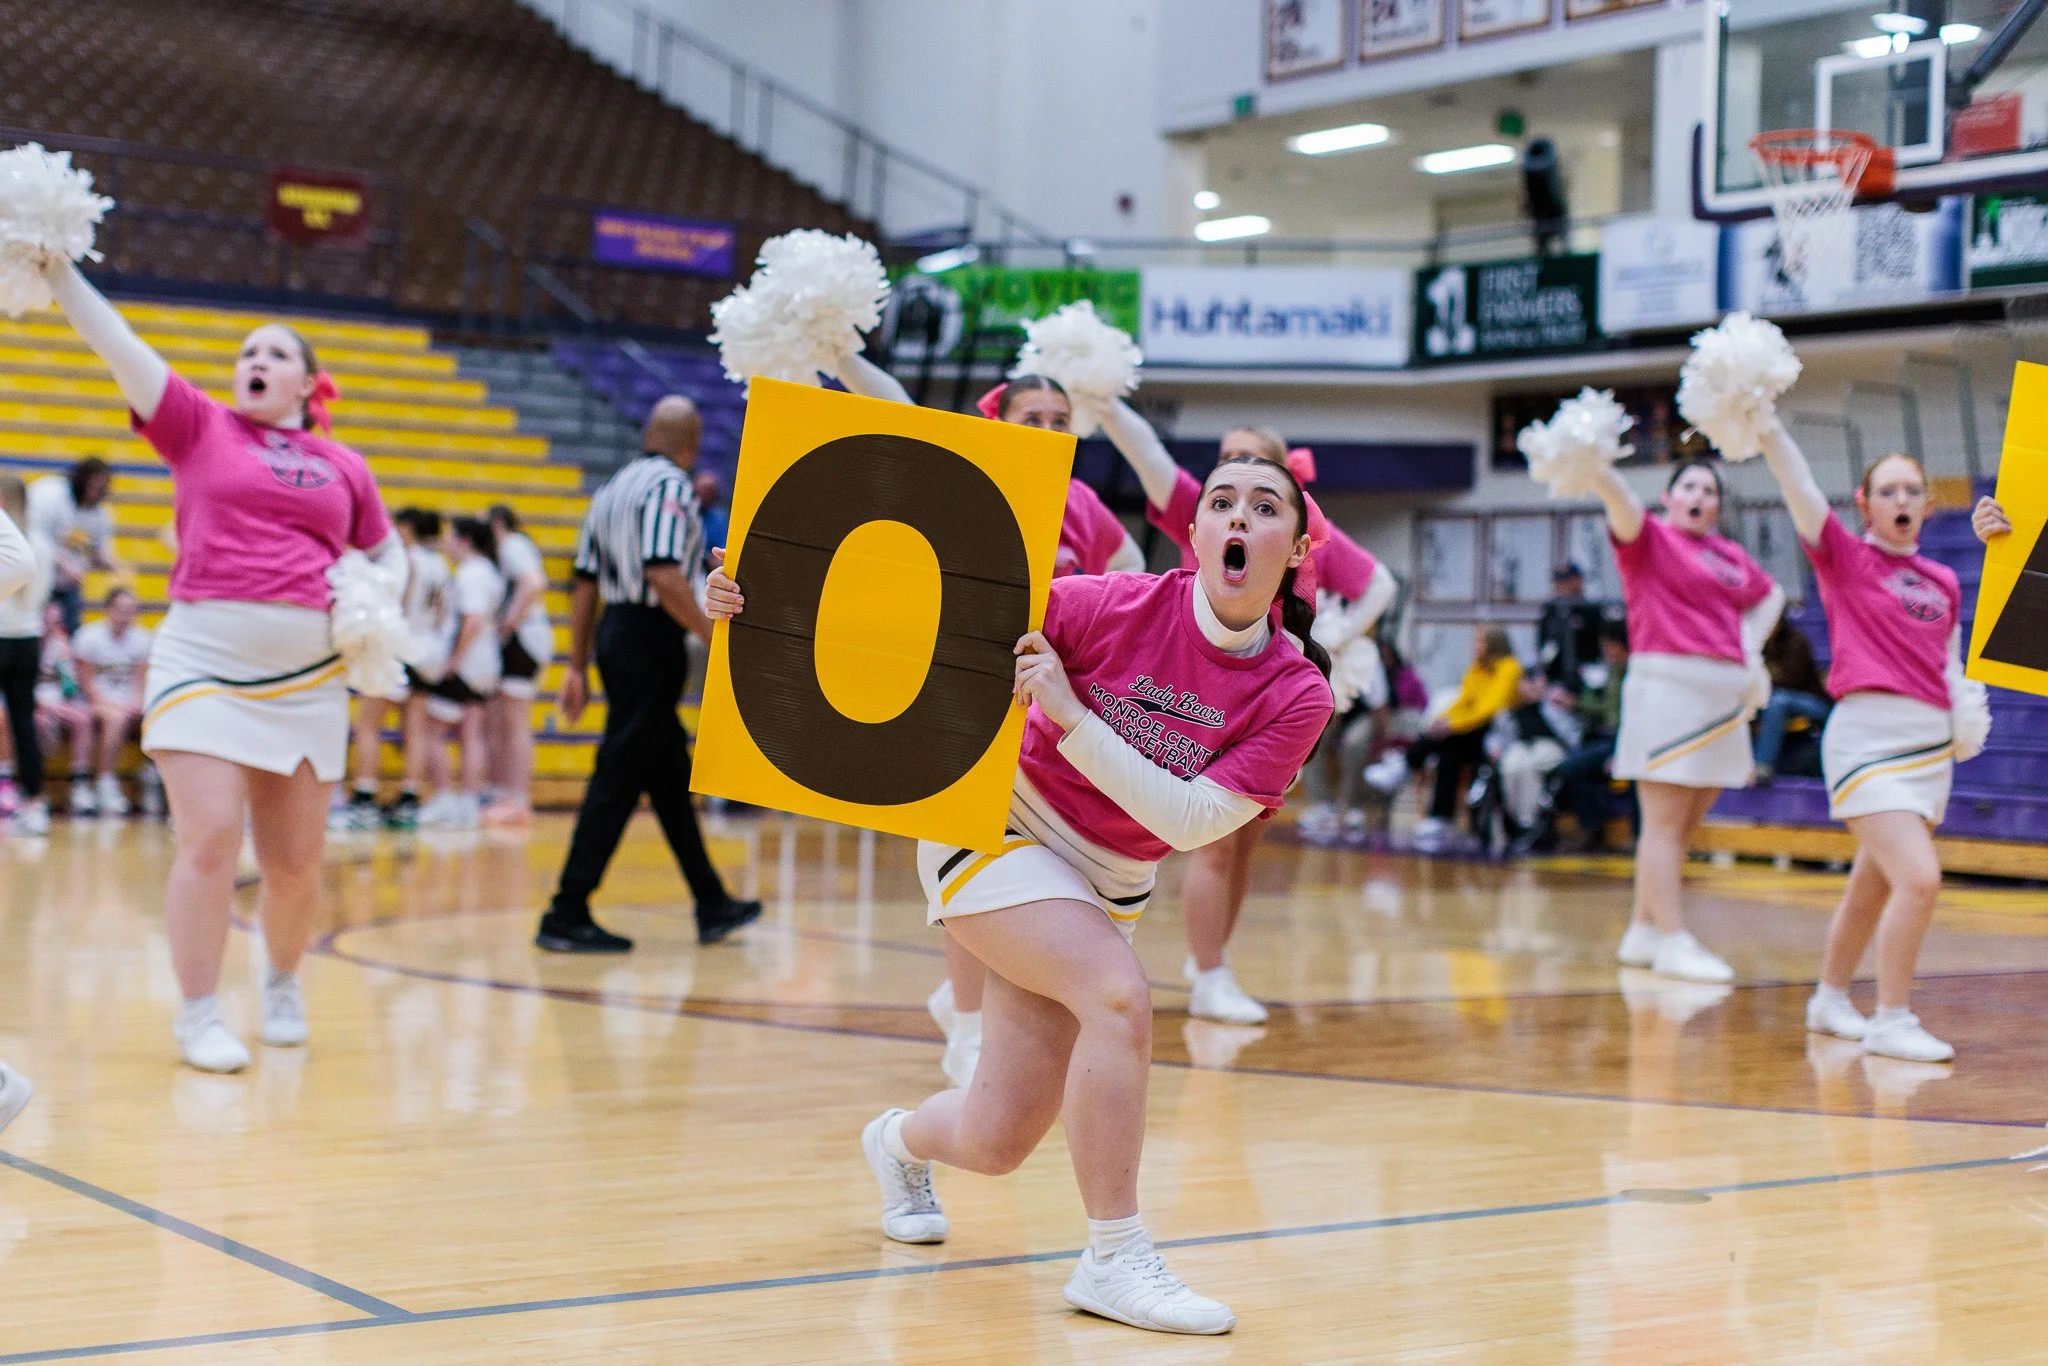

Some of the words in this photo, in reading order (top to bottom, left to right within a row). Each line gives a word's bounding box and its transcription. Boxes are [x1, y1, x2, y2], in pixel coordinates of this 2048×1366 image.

[1150, 294, 1390, 338] Huhtamaki
[1088, 682, 1166, 737] MONROE
[1129, 674, 1177, 709] Lady
[1177, 691, 1226, 724] Bears
[1100, 708, 1206, 775] BASKETBAL
